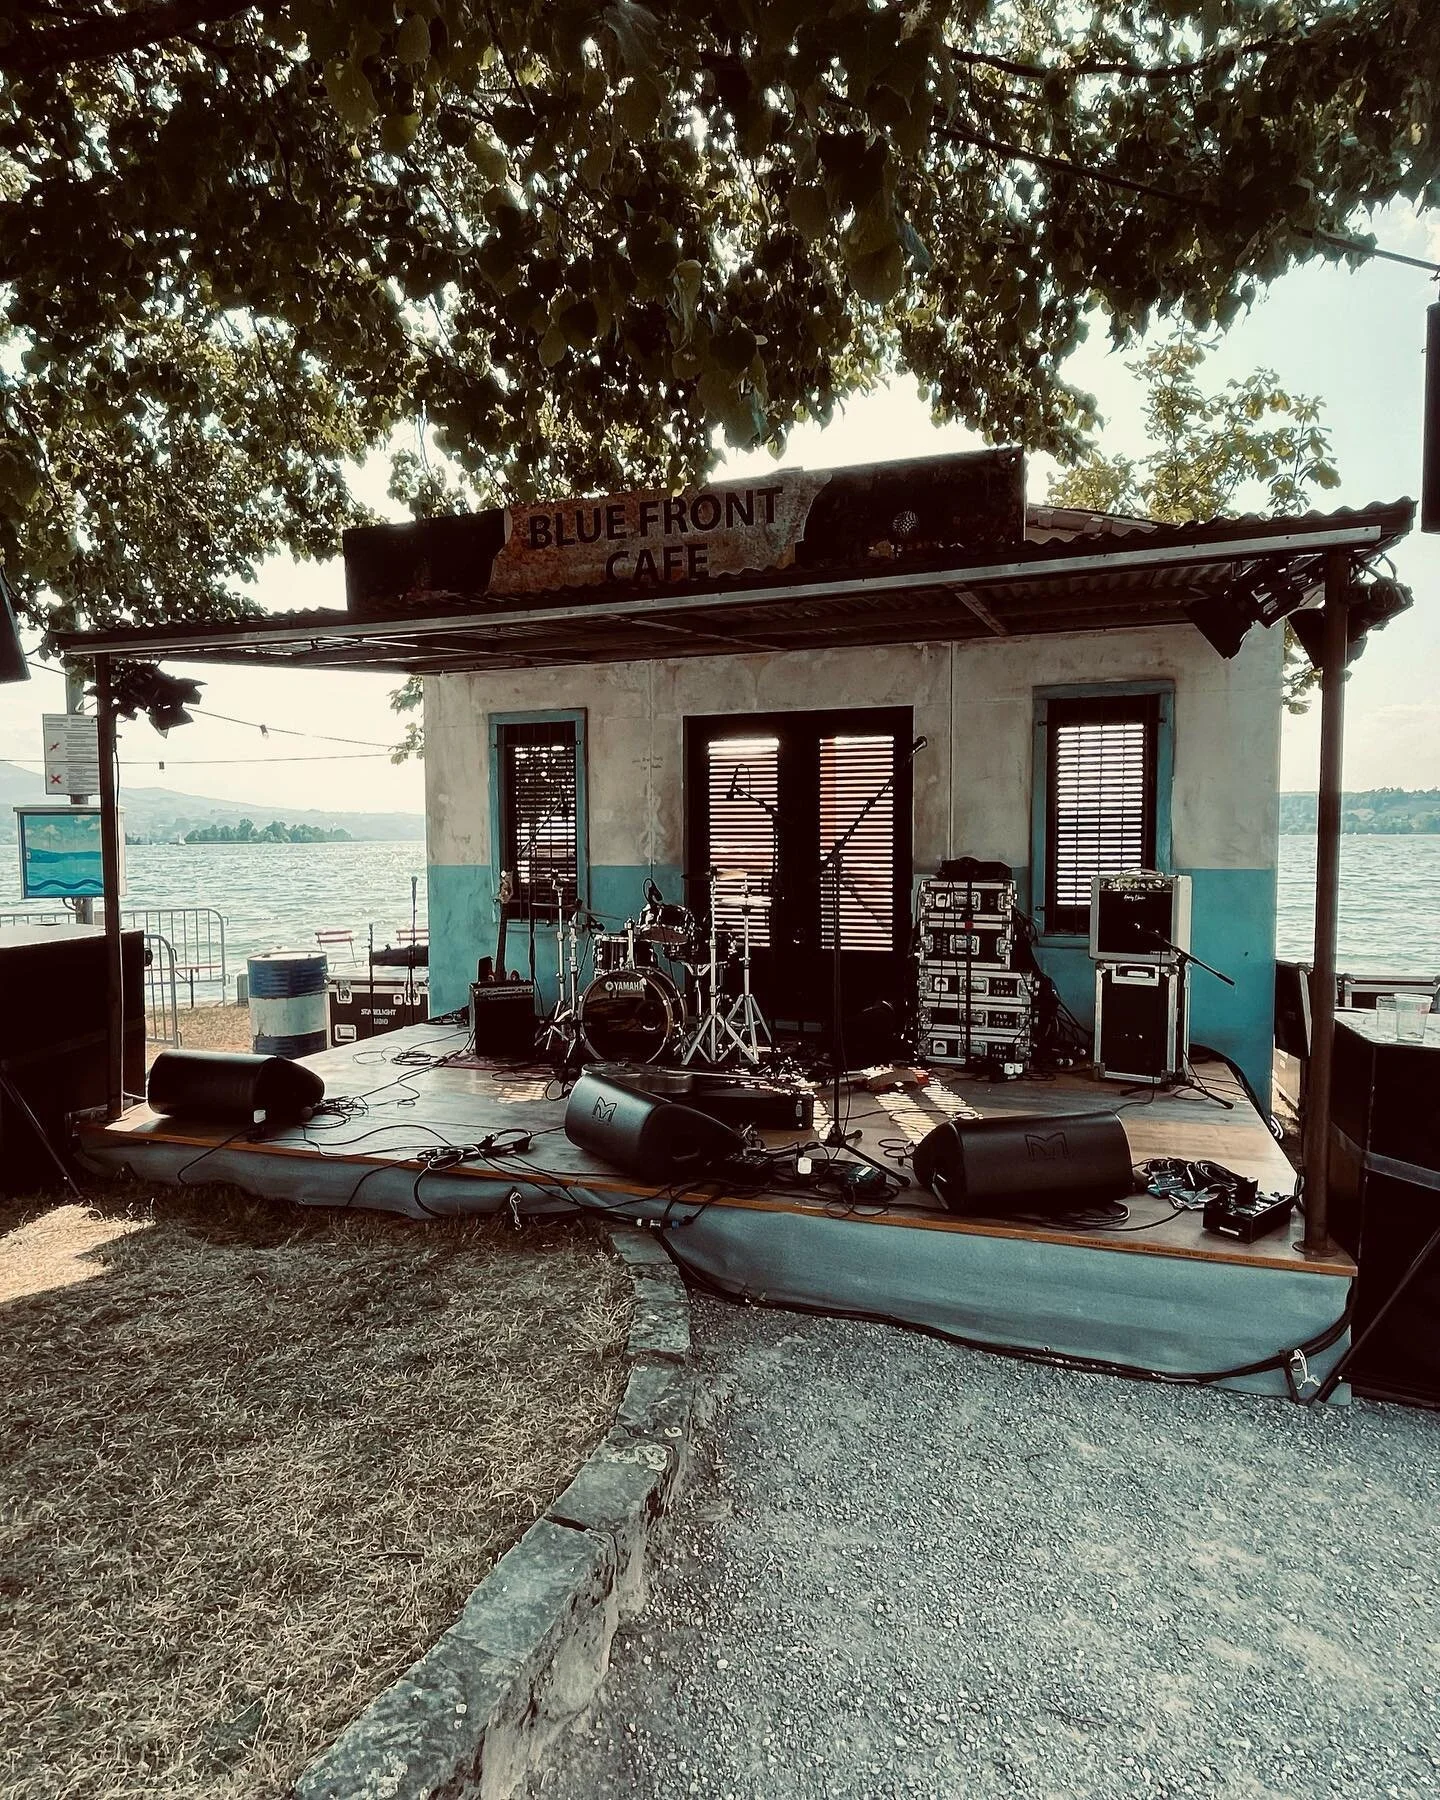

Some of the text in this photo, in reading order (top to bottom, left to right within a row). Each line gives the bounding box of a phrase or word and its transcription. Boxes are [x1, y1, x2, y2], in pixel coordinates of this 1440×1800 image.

[528, 486, 784, 550] BLUE FRONT
[605, 543, 711, 581] CAFE
[614, 981, 645, 992] YAMAHA
